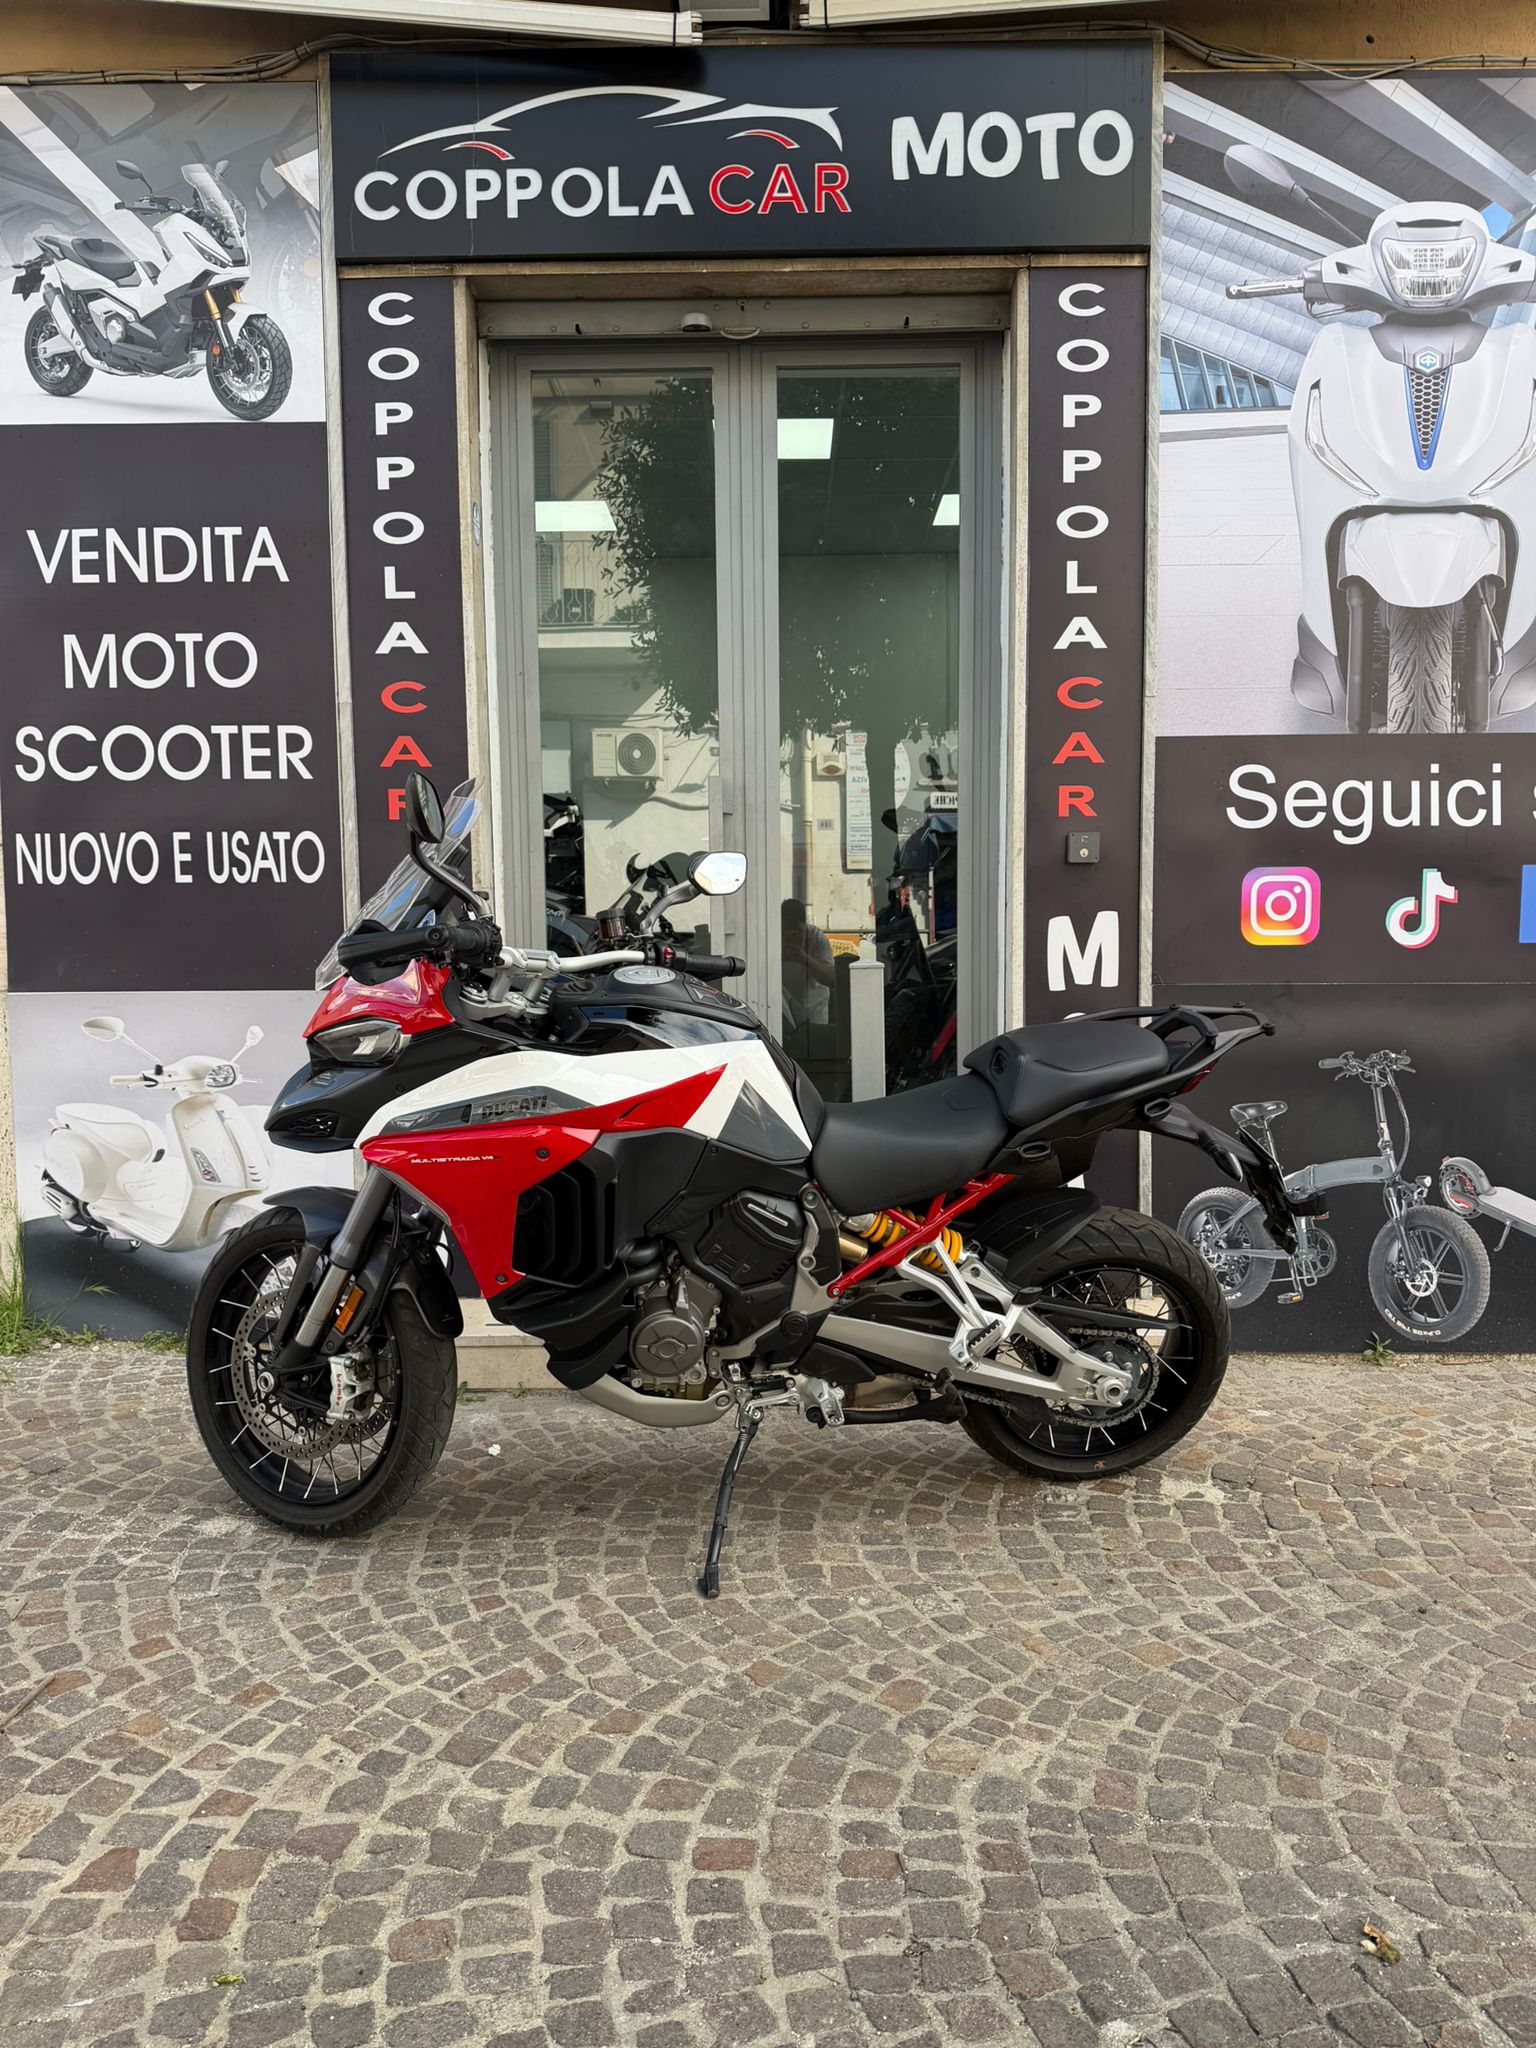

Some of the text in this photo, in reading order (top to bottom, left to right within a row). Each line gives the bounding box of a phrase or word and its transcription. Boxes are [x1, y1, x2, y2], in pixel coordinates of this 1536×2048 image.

[891, 109, 1134, 181] MOTO
[354, 163, 850, 221] COPPOLA CAR
[367, 291, 429, 655] COPPOLA
[27, 526, 290, 584] VENDITA
[1051, 282, 1110, 818] COPPOLA CAR
[63, 631, 258, 690] MOTO
[15, 724, 314, 782] SCOOTER
[1226, 762, 1502, 845] Seguici
[15, 830, 325, 886] NUOVO E USATO
[481, 1095, 549, 1119] DUCATI
[411, 1155, 480, 1164] MULTISTRADA
